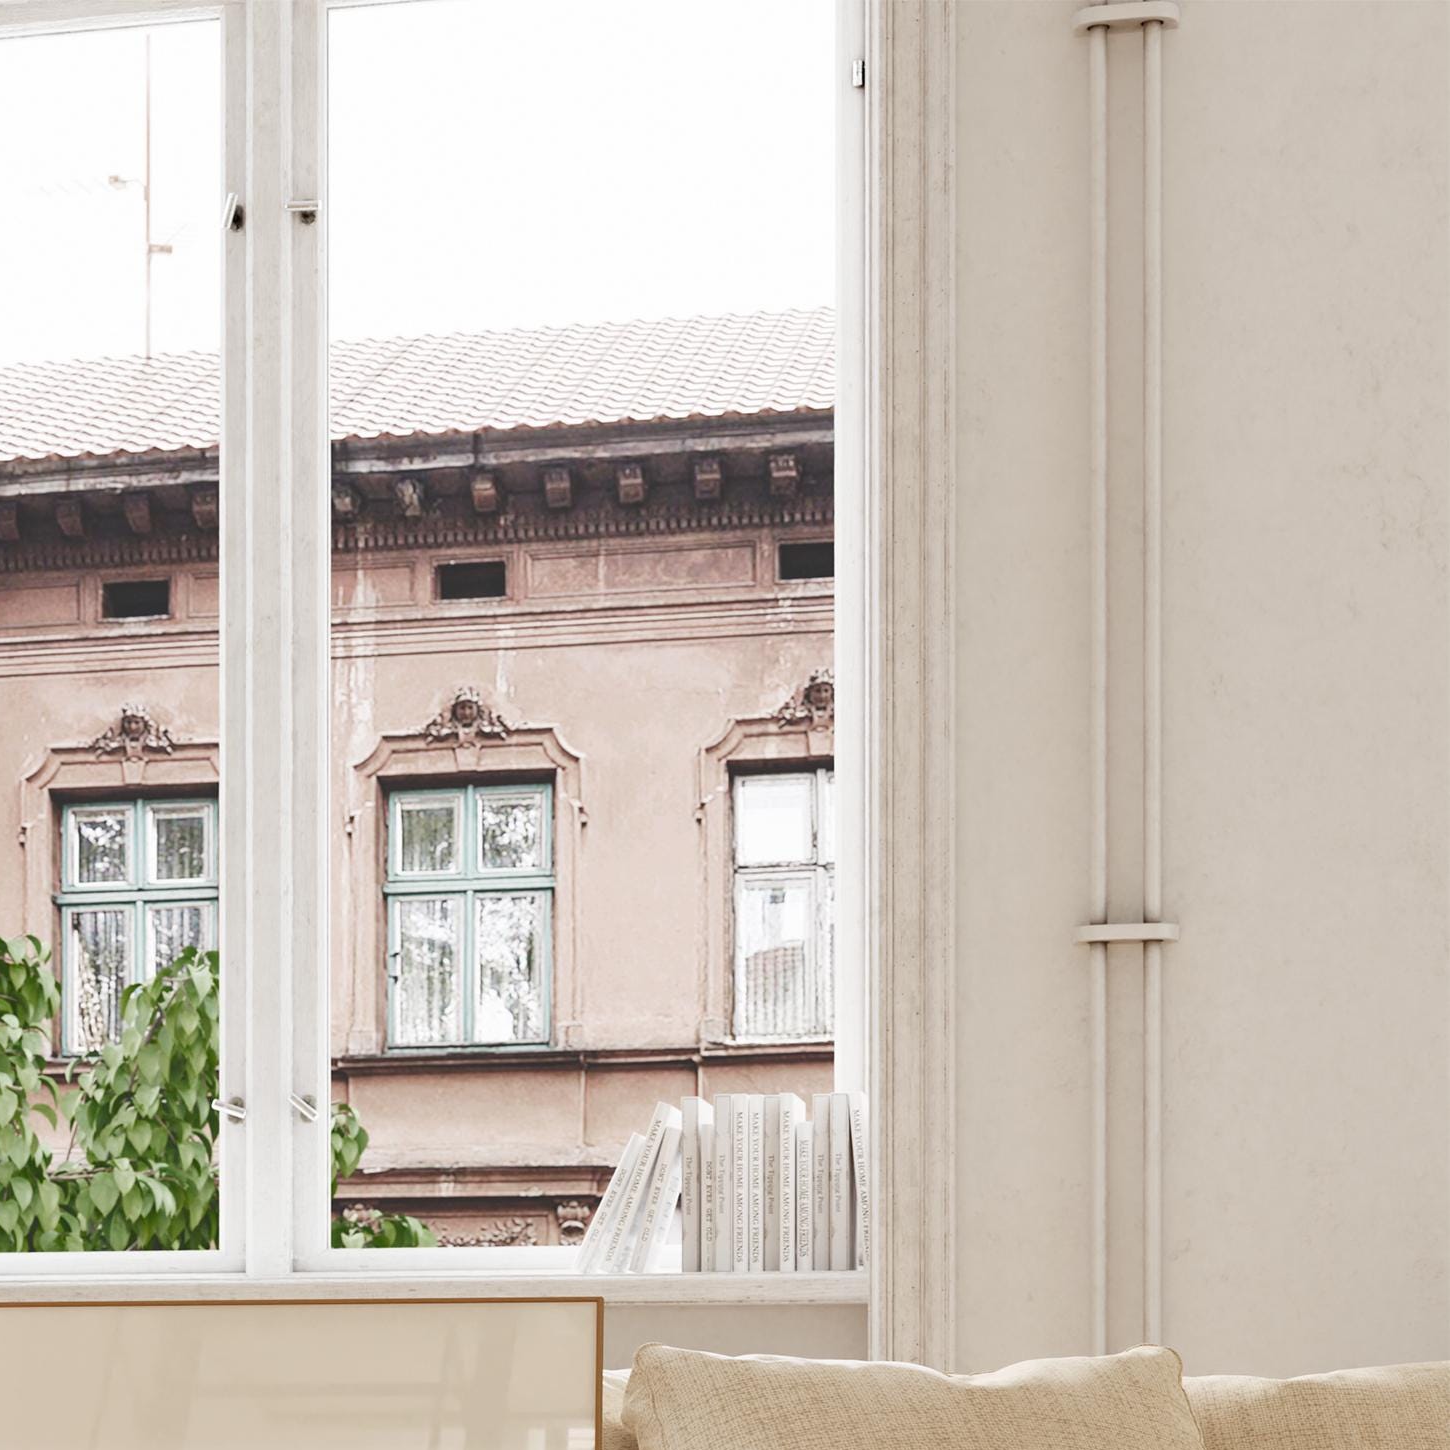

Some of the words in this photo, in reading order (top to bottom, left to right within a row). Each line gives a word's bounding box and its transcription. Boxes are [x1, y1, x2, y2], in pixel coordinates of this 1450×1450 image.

[649, 1119, 662, 1143] MAKE
[735, 1111, 743, 1134] MAKE
[852, 1109, 861, 1133] MAKE
[639, 1144, 653, 1168] YOUR
[735, 1137, 743, 1163] YOUR
[855, 1135, 863, 1160] YOUR
[630, 1168, 645, 1194] HOME
[735, 1164, 743, 1189] HOME
[618, 1196, 634, 1227] AMONG
[646, 1208, 655, 1224] GET
[735, 1192, 743, 1225] AMONG
[860, 1190, 869, 1222] AMONG
[605, 1227, 623, 1263] FRIENDS
[735, 1226, 743, 1263] FRIENDS
